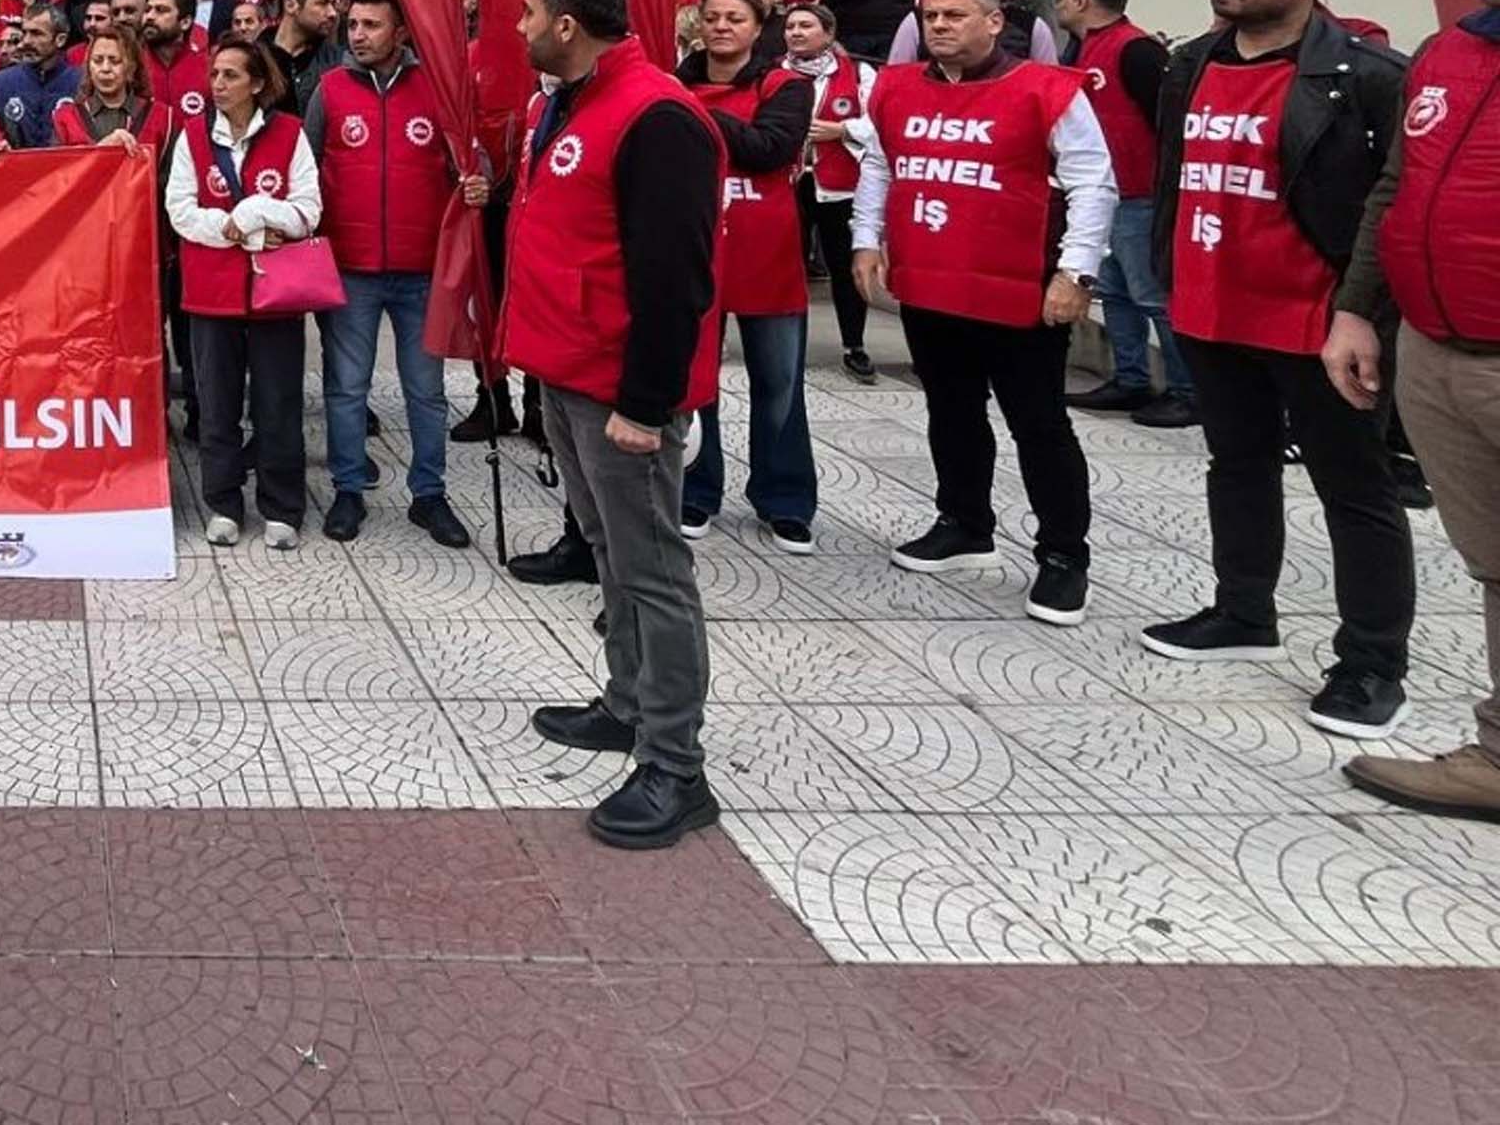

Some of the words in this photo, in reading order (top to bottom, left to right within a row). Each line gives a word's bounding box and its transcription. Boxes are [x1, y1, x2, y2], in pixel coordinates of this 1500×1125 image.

[903, 112, 997, 145] DİSK
[1183, 105, 1269, 145] DİSK
[912, 192, 949, 232] İŞ
[1191, 206, 1223, 252] İŞ
